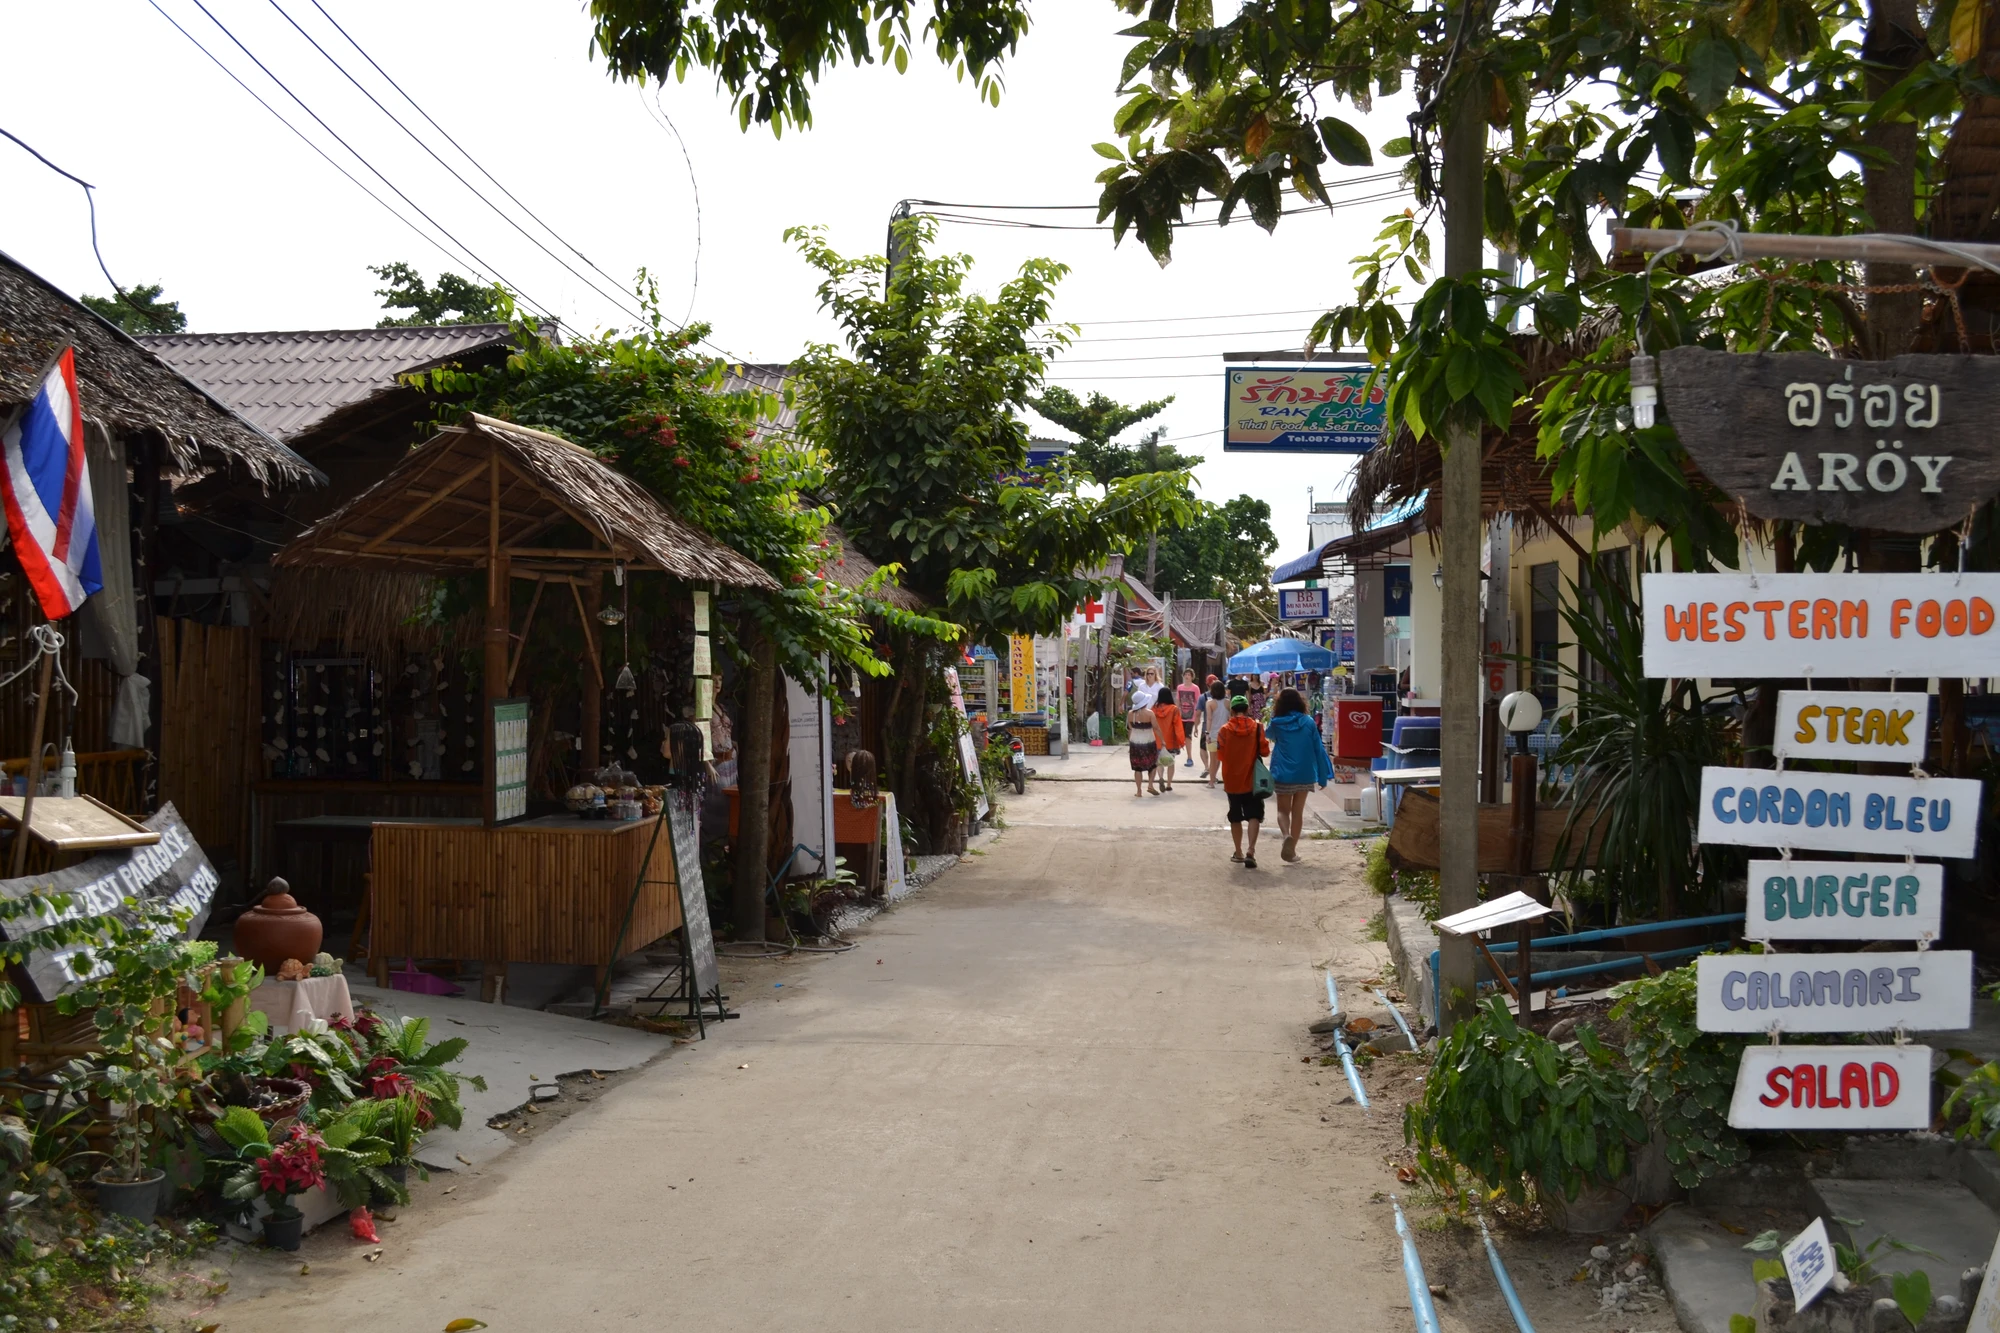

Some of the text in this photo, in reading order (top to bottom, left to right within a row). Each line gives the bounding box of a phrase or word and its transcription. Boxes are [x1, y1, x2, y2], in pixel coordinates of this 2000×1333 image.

[1258, 406, 1373, 419] RAK LAY
[1784, 365, 1940, 428] อร่อย
[1239, 420, 1268, 431] Thai
[1271, 420, 1304, 431] Food
[1309, 420, 1319, 431] &
[1324, 421, 1351, 431] Sea
[1770, 439, 1953, 493] ARÖY
[1296, 591, 1314, 602] BB
[1664, 596, 1995, 642] WESTERN FOOD
[1013, 640, 1023, 678] BAMBOO
[1794, 705, 1915, 746] STEAK
[1712, 785, 1951, 833] CORDON BLEU
[76, 872, 126, 918] BEST
[118, 824, 190, 895] PARADISE
[189, 863, 219, 905] SPA
[1763, 873, 1920, 921] BURGER
[1721, 966, 1922, 1012] CALAMARI
[1759, 1061, 1900, 1109] SALAD
[1796, 1240, 1826, 1286] OPEN
